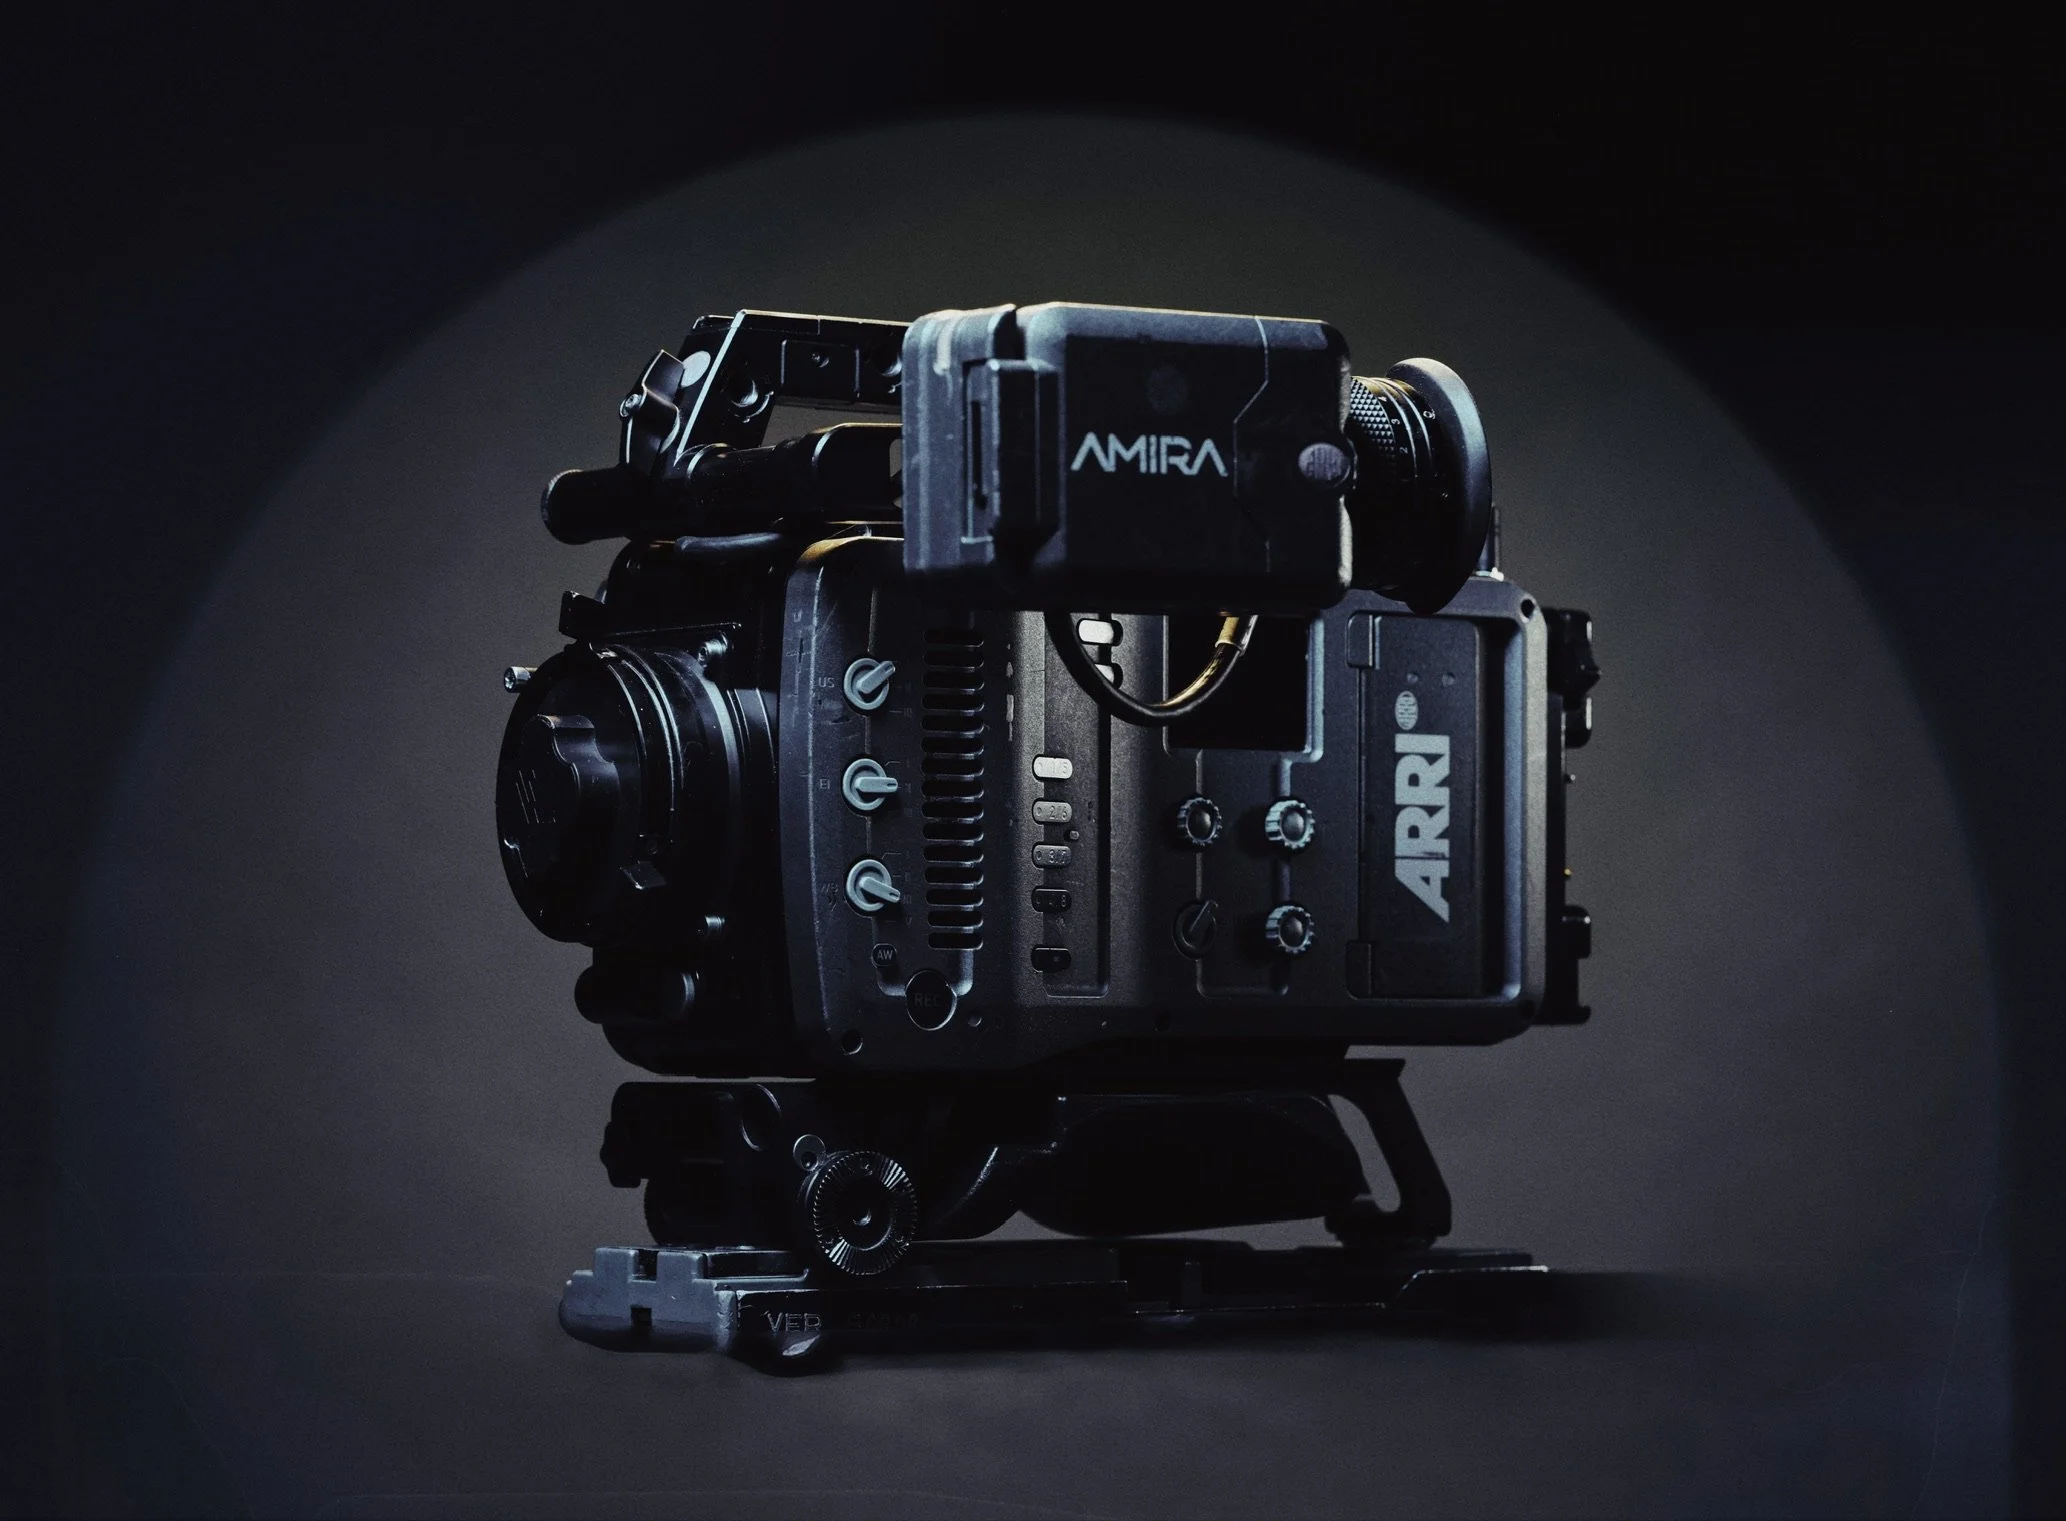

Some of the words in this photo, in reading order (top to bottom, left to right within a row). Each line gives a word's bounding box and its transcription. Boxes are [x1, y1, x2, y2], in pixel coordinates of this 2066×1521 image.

[1069, 430, 1230, 478] AMIRA
[1393, 732, 1451, 925] ARRI
[876, 949, 894, 961] AW
[766, 1311, 823, 1333] VER
